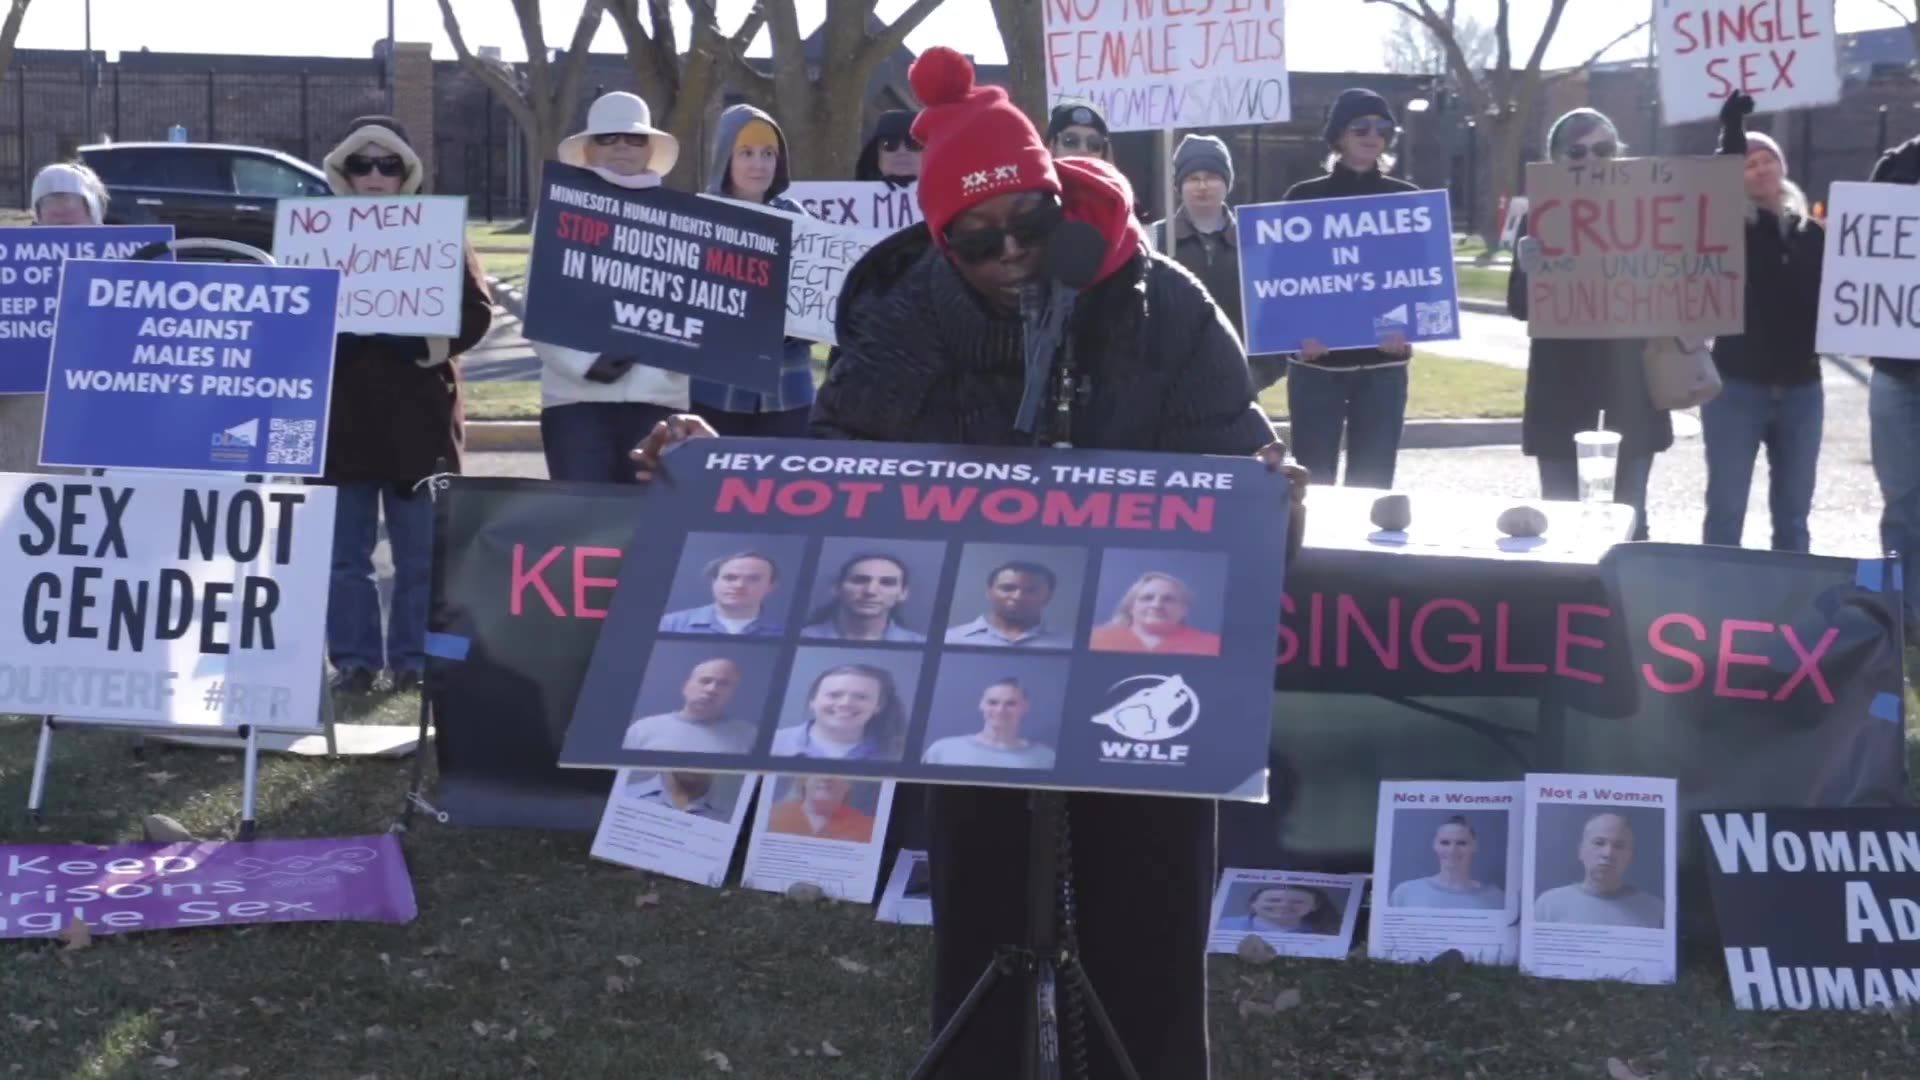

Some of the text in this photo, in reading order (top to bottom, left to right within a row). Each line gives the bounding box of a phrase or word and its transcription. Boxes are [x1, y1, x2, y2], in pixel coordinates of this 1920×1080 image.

[1673, 0, 1820, 54] SINGLE
[1048, 18, 1285, 87] FEMALE JAILS
[1705, 50, 1796, 98] SEX
[1568, 163, 1673, 187] THIS IS
[290, 202, 422, 235] NO MEN
[550, 184, 779, 255] MINNESOTA HUMAN RIGHTS VIOLATION:
[1256, 206, 1432, 245] NO MALES
[1528, 192, 1729, 257] CRUEL
[15, 243, 70, 261] MAN
[76, 242, 96, 259] IS
[558, 211, 769, 287] STOP HOUSING MALES
[1332, 246, 1360, 265] IN
[23, 266, 53, 284] OF
[562, 248, 747, 317] IN WOMEN'S JAILS!
[1253, 267, 1443, 298] WOMEN'S JAILS
[1601, 254, 1730, 281] UNUSUAL
[89, 278, 310, 315] DEMOCRATS
[339, 287, 444, 318] ISONS
[1533, 272, 1739, 326] PUNISHMENT
[137, 317, 252, 341] AGAINST
[132, 344, 251, 368] MALES IN
[64, 369, 314, 400] WOMEN'S PRISONS
[706, 452, 1234, 490] HEY CORRECTIONS, THESE ARE
[715, 478, 1216, 533] NOT WOMEN
[19, 482, 306, 565] SEX NOT
[22, 566, 281, 655] GENDER
[1642, 612, 1840, 704] SEX
[1393, 792, 1513, 804] Not a Woman
[1540, 787, 1663, 802] Not a Woman
[8, 854, 196, 877] Keep
[0, 878, 245, 906] risons
[0, 900, 316, 934] gle Sex
